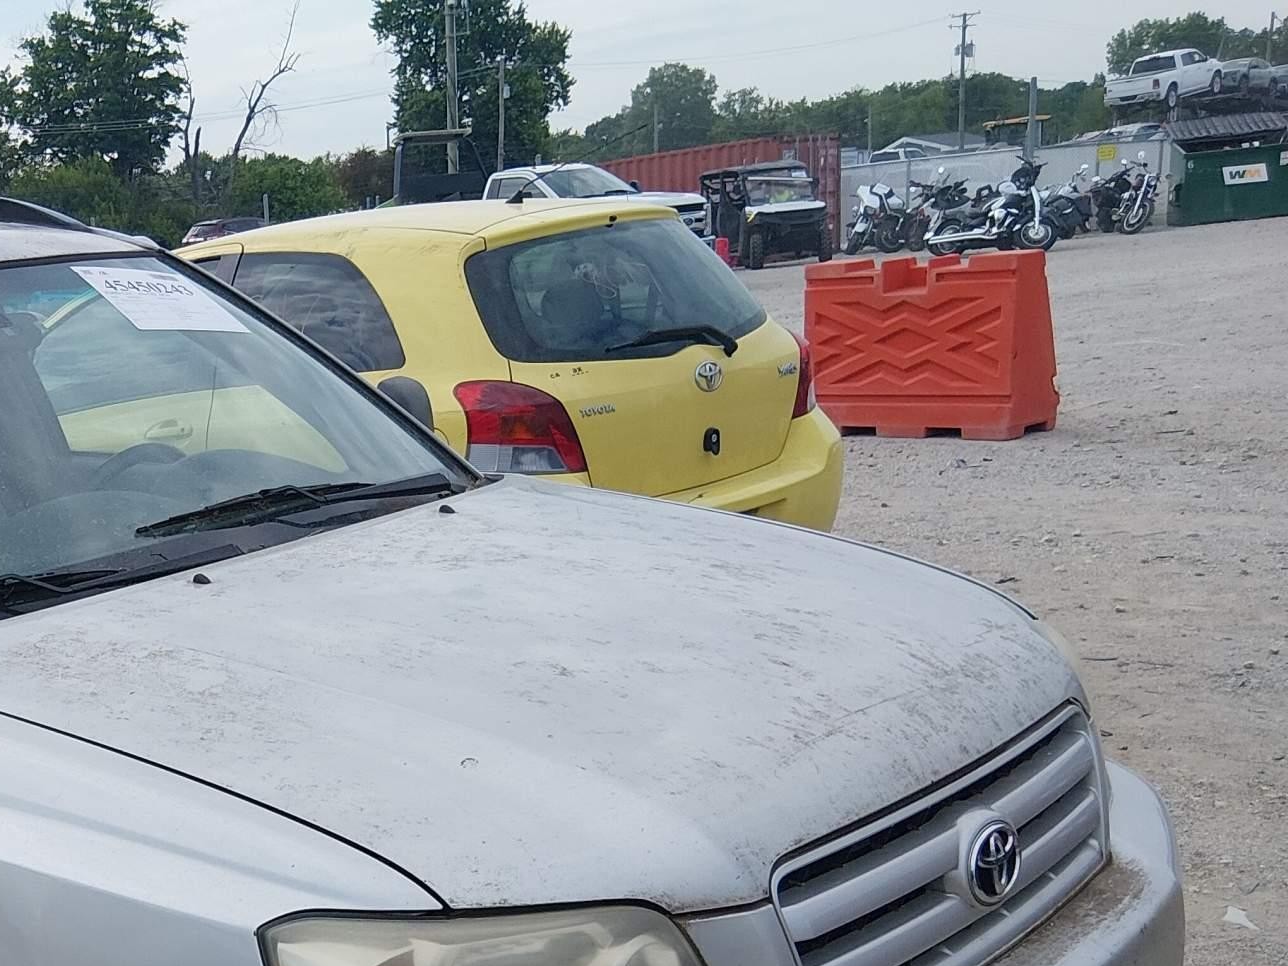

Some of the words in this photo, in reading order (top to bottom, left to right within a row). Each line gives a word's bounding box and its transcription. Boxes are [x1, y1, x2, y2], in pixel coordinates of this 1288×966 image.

[1228, 168, 1263, 180] WM
[104, 279, 194, 296] 45450243
[578, 404, 616, 418] TOYOTA
